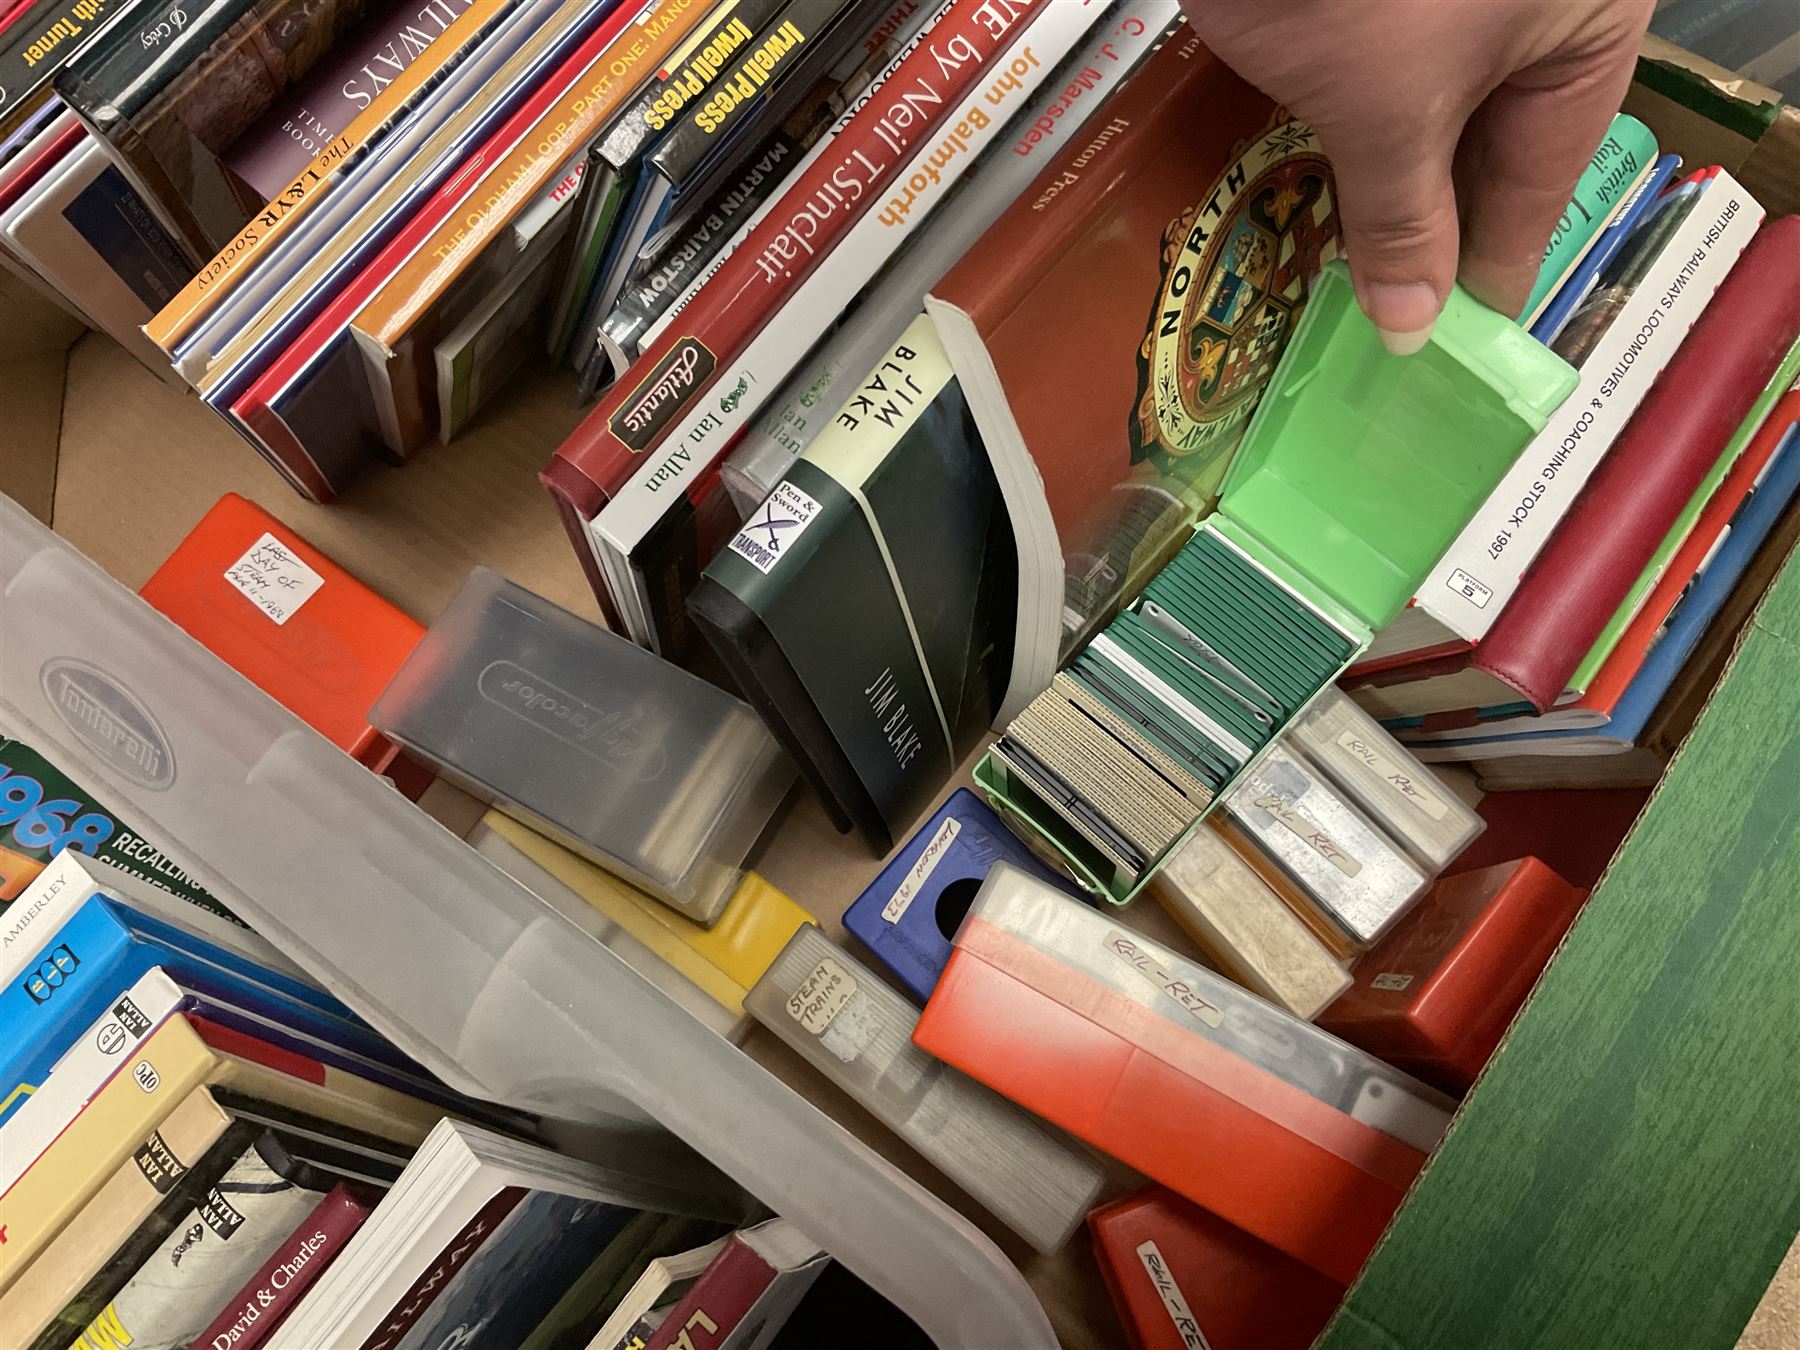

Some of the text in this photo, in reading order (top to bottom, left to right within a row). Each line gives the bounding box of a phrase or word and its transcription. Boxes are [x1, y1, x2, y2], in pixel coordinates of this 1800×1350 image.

[22, 17, 82, 67] Turner
[140, 23, 171, 50] Crécy
[342, 0, 474, 110] ILWAYS
[930, 34, 982, 80] by
[572, 76, 613, 117] PART
[610, 39, 649, 76] ONE:
[644, 17, 753, 130] Irwell Press
[695, 20, 805, 134] Irwell Press
[1012, 17, 1145, 158] C. J. Marsden
[873, 77, 943, 155] Neil
[877, 47, 1041, 228] John Balmforth
[320, 136, 354, 167] The
[1032, 118, 1130, 211] Hutton Press
[1592, 137, 1623, 173] Rail
[257, 169, 321, 228] L&YR
[549, 175, 577, 202] THE
[719, 142, 789, 216] MARTIN
[1596, 151, 1637, 204] British
[198, 228, 259, 290] Society
[639, 214, 724, 308] BAIRSTOW
[1160, 162, 1246, 338] NORTH
[623, 346, 698, 431] Atlantic
[837, 346, 917, 432] BLAKE
[873, 374, 922, 429] JIM
[1487, 199, 1740, 560] BRITISH RAILWAYS LOCOMOTIVES & COACHING STOCK 1997
[764, 418, 800, 455] Allan
[778, 404, 807, 432] Ian
[644, 411, 723, 493] Ian Allan
[771, 493, 809, 523] Sword
[780, 484, 814, 513] Pen &
[250, 549, 304, 590] DAY OF
[262, 542, 302, 568] LAST
[732, 533, 776, 569] TRANSPORT
[1458, 573, 1488, 595] PLATFORM
[1462, 584, 1475, 597] 5
[865, 667, 921, 770] JIM BLAKE
[2, 875, 68, 948] AMBERLEY
[118, 1011, 138, 1033] IAN
[122, 999, 150, 1029] ALLAN
[805, 975, 841, 1024] TRAINS
[135, 1064, 158, 1089] OPC
[139, 1156, 164, 1184] IAN
[147, 1134, 184, 1177] ALLAN
[200, 1204, 221, 1230] IAN
[208, 1187, 243, 1225] ALLAN
[211, 1230, 327, 1350] David & Charles
